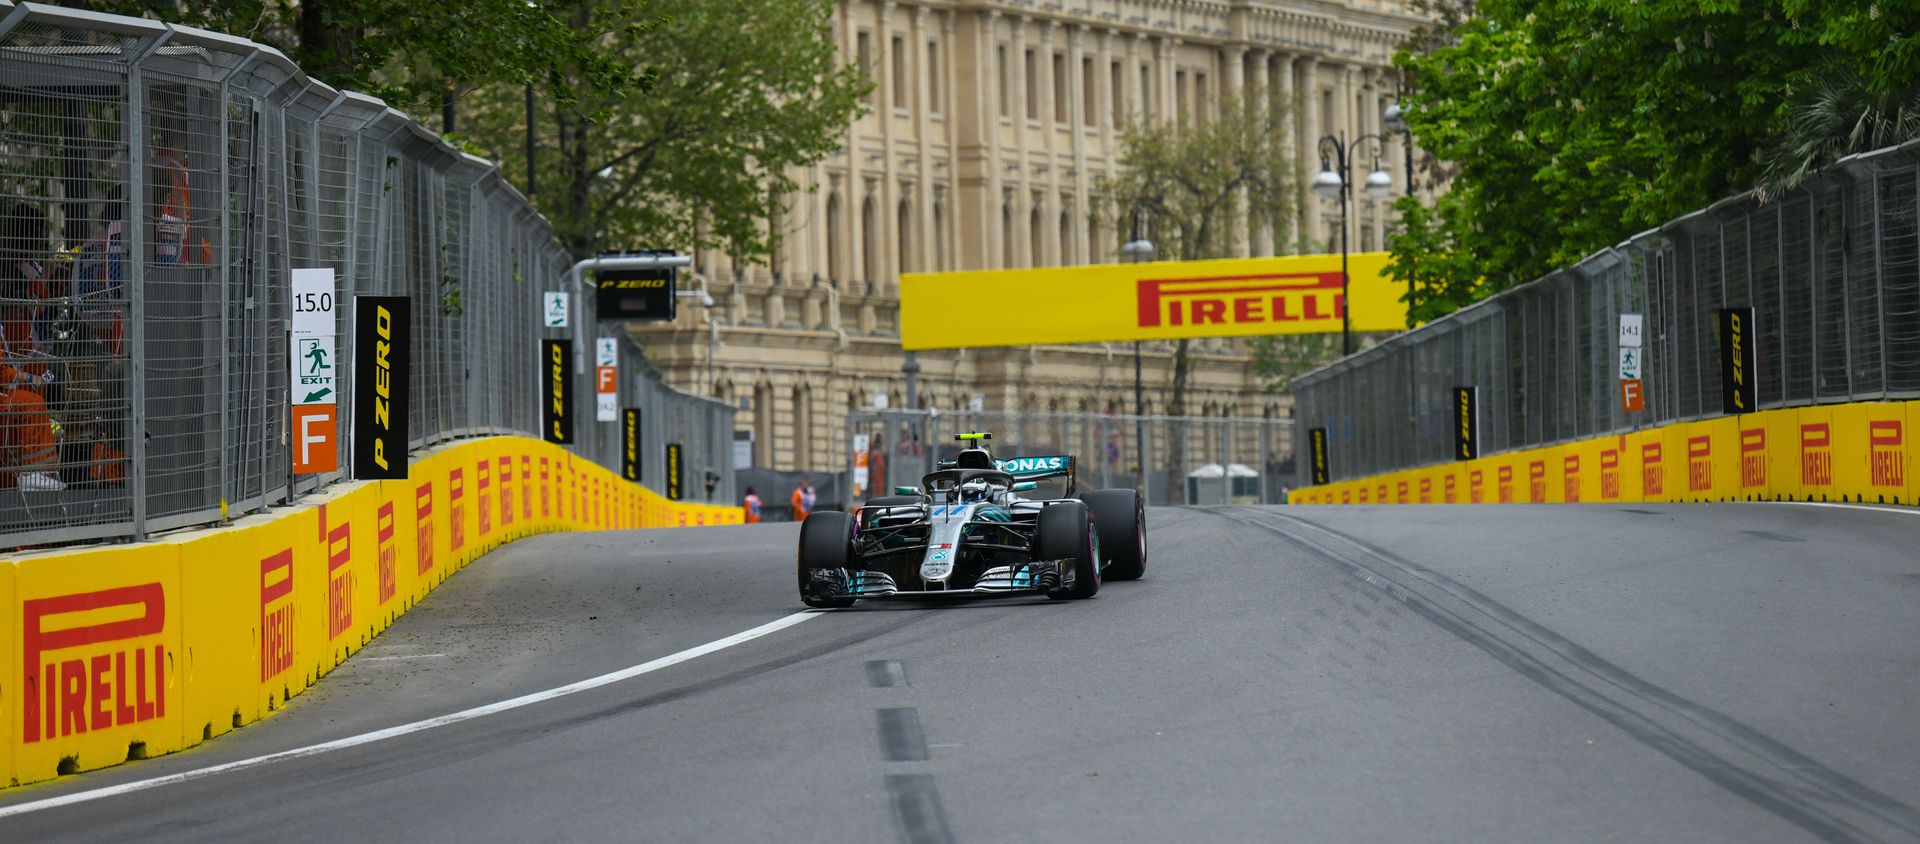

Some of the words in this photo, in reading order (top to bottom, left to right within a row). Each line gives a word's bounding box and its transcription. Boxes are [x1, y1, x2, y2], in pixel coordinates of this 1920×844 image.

[295, 292, 332, 312] 15.0
[616, 279, 666, 289] ZERO
[1136, 271, 1350, 328] PIRELLI
[1621, 325, 1639, 336] 14.1
[1731, 312, 1743, 386] ZERO
[301, 377, 332, 385] EXIT
[375, 305, 391, 431] ZERO
[552, 343, 564, 418] ZERO
[600, 368, 613, 391] F
[1625, 384, 1638, 408] F
[1734, 389, 1744, 409] P
[302, 414, 330, 465] F
[374, 438, 388, 471] P
[553, 420, 564, 441] P
[1741, 428, 1766, 488] PIRELLI
[1801, 422, 1831, 486] PIRELLI
[1870, 420, 1904, 487] PIRELLI
[1642, 442, 1662, 496] PIRELLI
[1688, 435, 1712, 492] PIRELLI
[328, 522, 353, 642] PIRELLI
[260, 547, 294, 684] PIRELLI
[22, 581, 166, 744] PIRELLI
